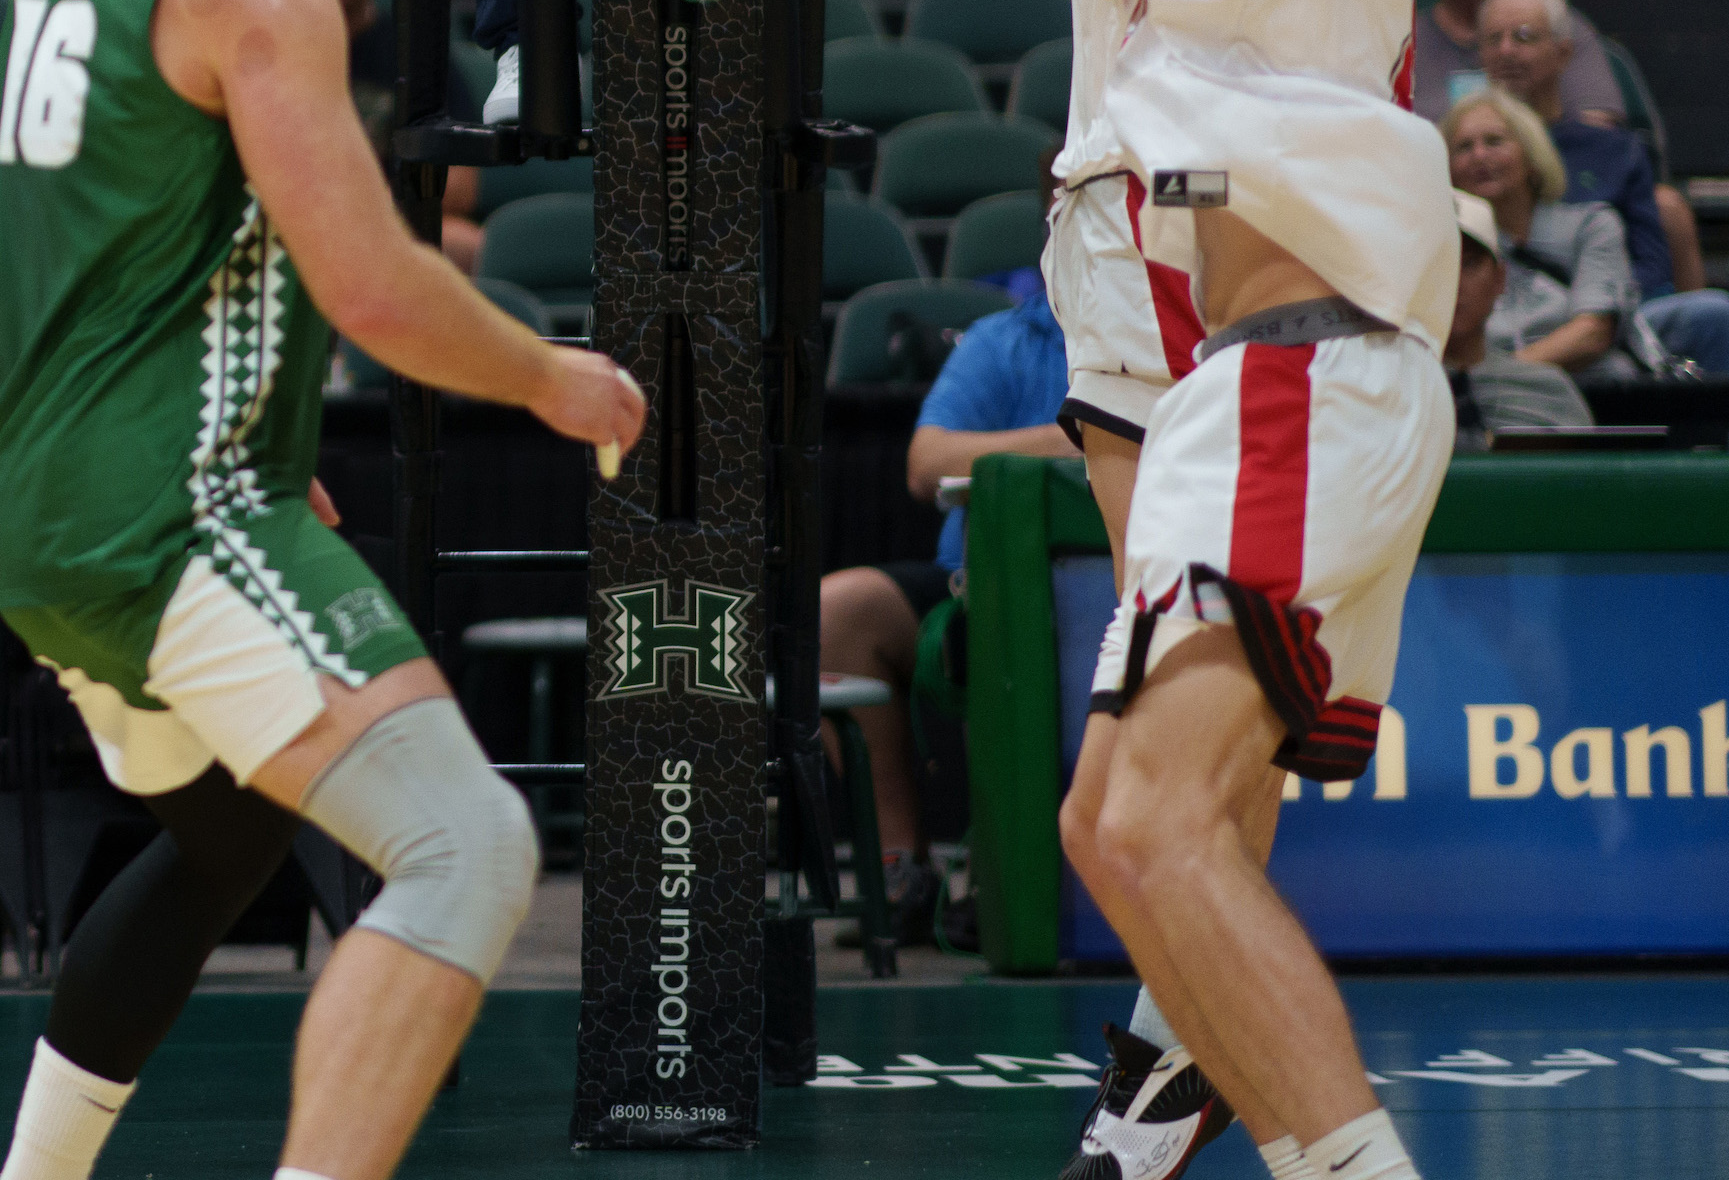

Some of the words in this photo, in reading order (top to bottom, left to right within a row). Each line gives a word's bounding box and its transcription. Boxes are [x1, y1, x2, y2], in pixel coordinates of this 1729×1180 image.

[663, 26, 691, 129] sports
[596, 578, 757, 704] H
[653, 758, 696, 898] sports
[610, 1104, 650, 1121] (800)
[654, 1106, 727, 1121] 556-3198
